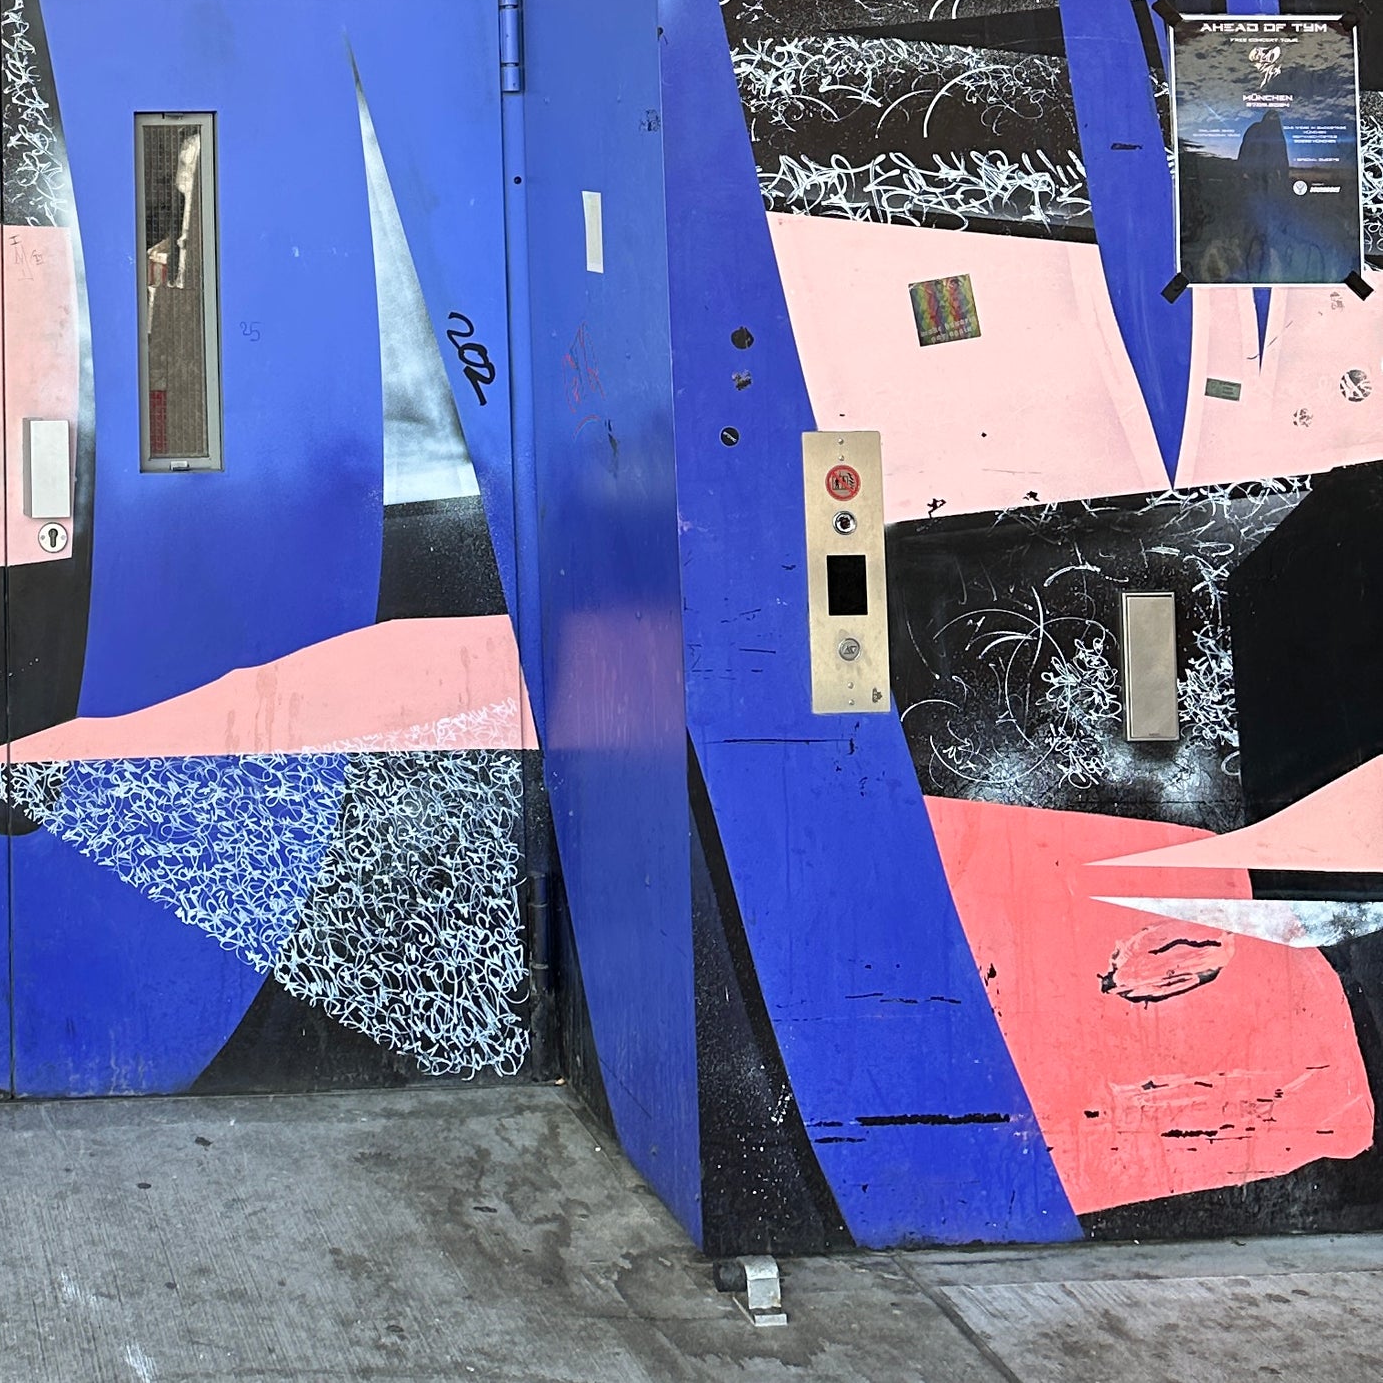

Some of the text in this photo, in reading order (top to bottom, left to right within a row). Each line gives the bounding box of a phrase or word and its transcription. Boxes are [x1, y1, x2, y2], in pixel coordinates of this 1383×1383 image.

[1199, 23, 1327, 32] AHEAD OF TYM
[1242, 93, 1293, 101] MÜNCHEN
